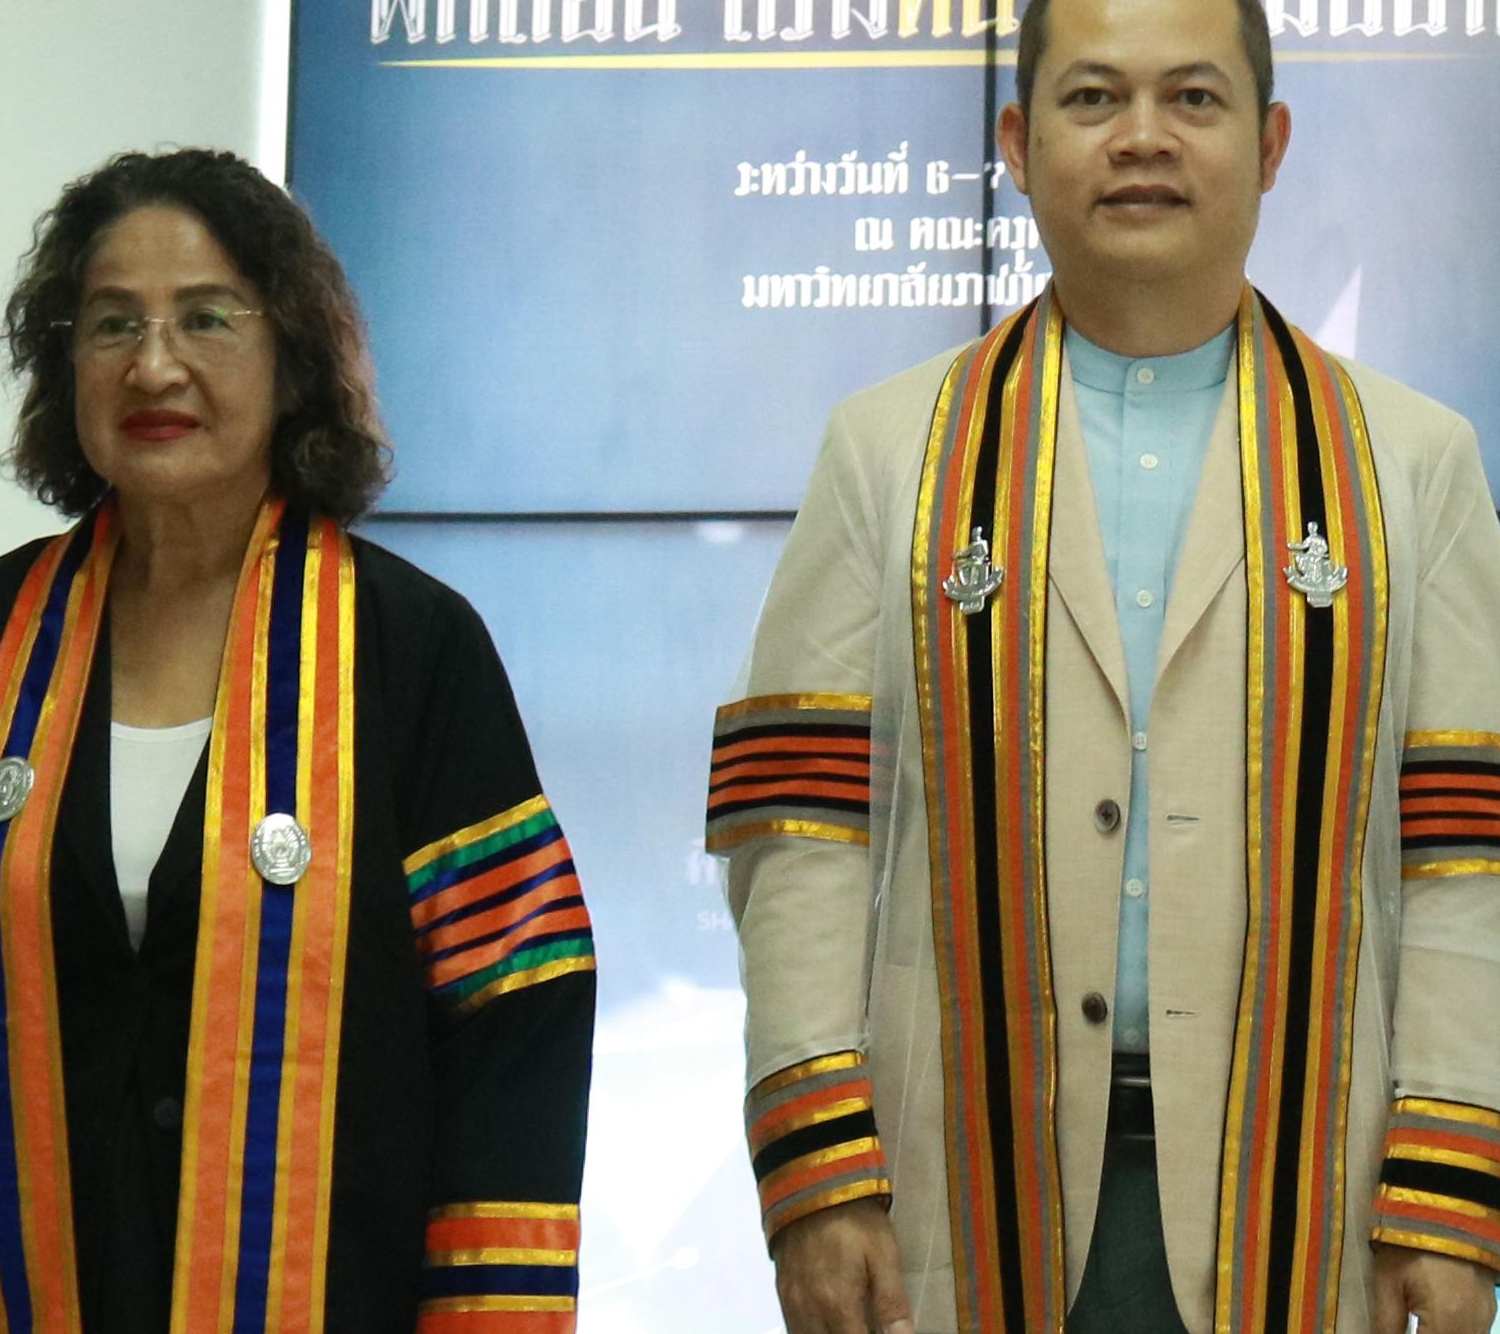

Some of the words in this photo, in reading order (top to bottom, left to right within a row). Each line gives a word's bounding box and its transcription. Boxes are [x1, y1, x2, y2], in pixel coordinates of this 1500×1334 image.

[734, 140, 909, 196] ระหว่างวันที่
[855, 217, 893, 250] ณ
